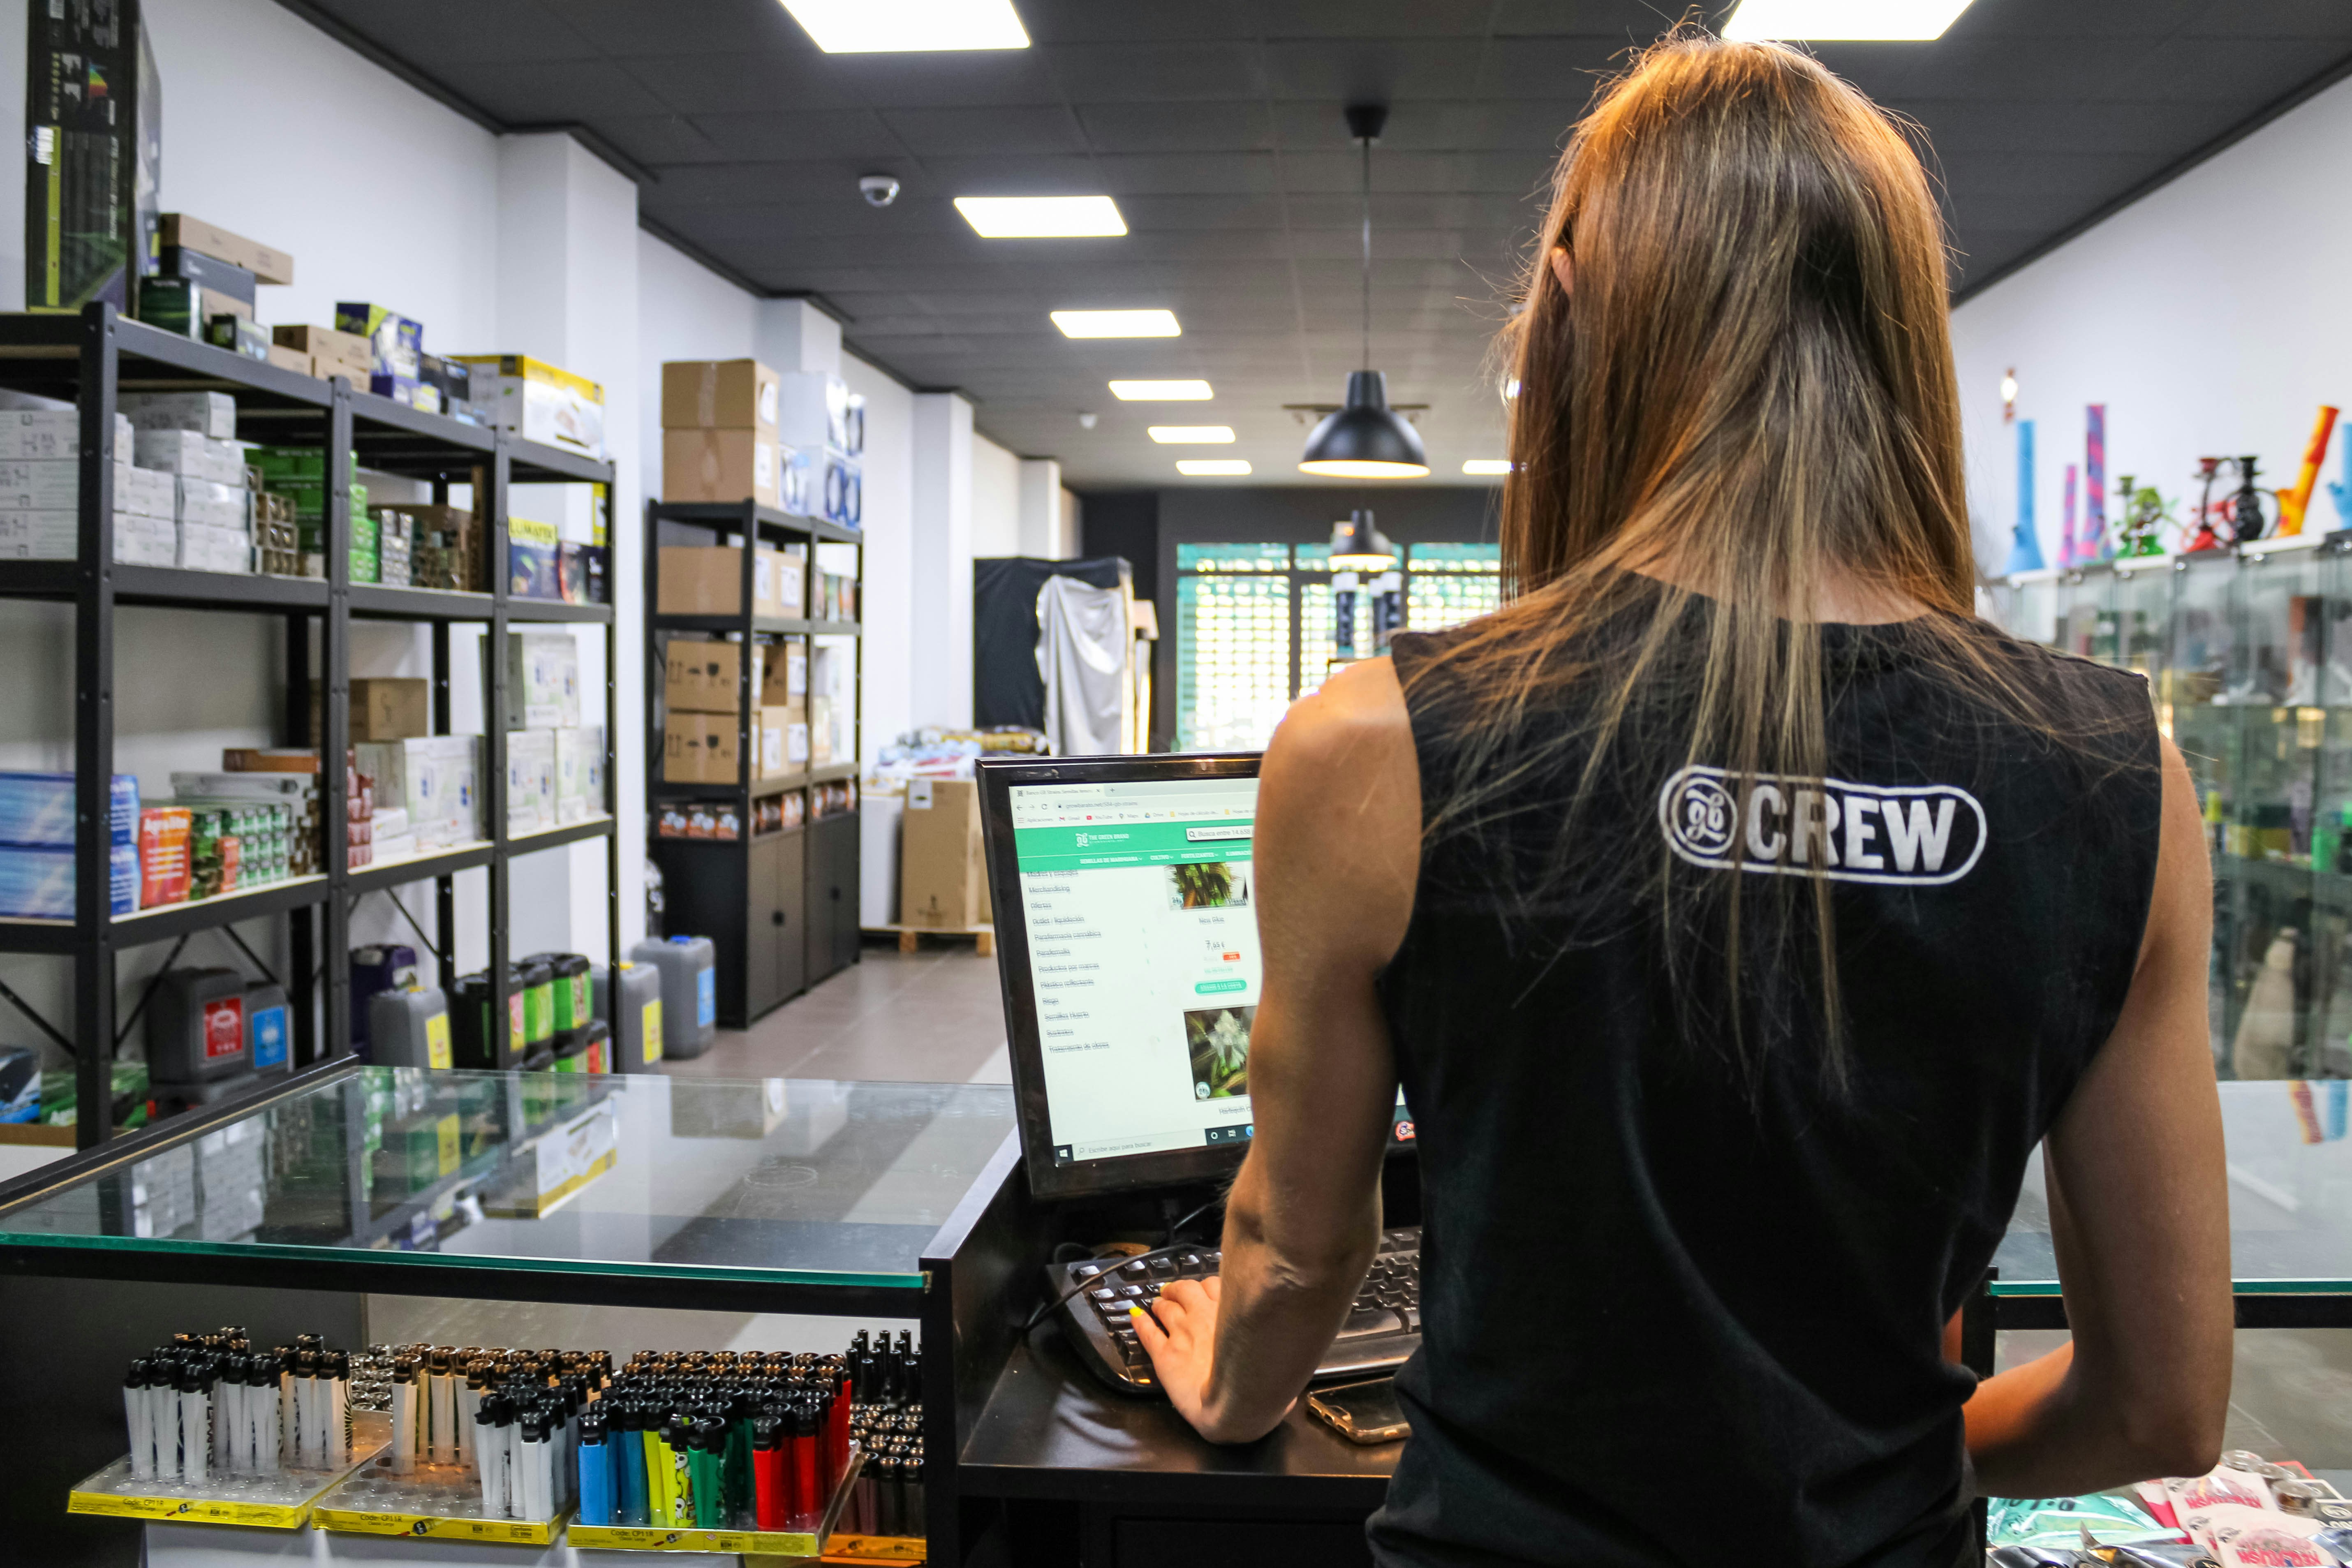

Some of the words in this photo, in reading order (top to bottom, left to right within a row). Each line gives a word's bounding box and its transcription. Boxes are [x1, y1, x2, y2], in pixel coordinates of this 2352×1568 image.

[1746, 785, 1957, 872] CREW
[1029, 885, 1071, 894] Merchandising
[1054, 916, 1085, 924] liquidación
[1038, 965, 1068, 974] Productos
[1042, 997, 1059, 1006] Riego
[1045, 1013, 1069, 1022] Semillas
